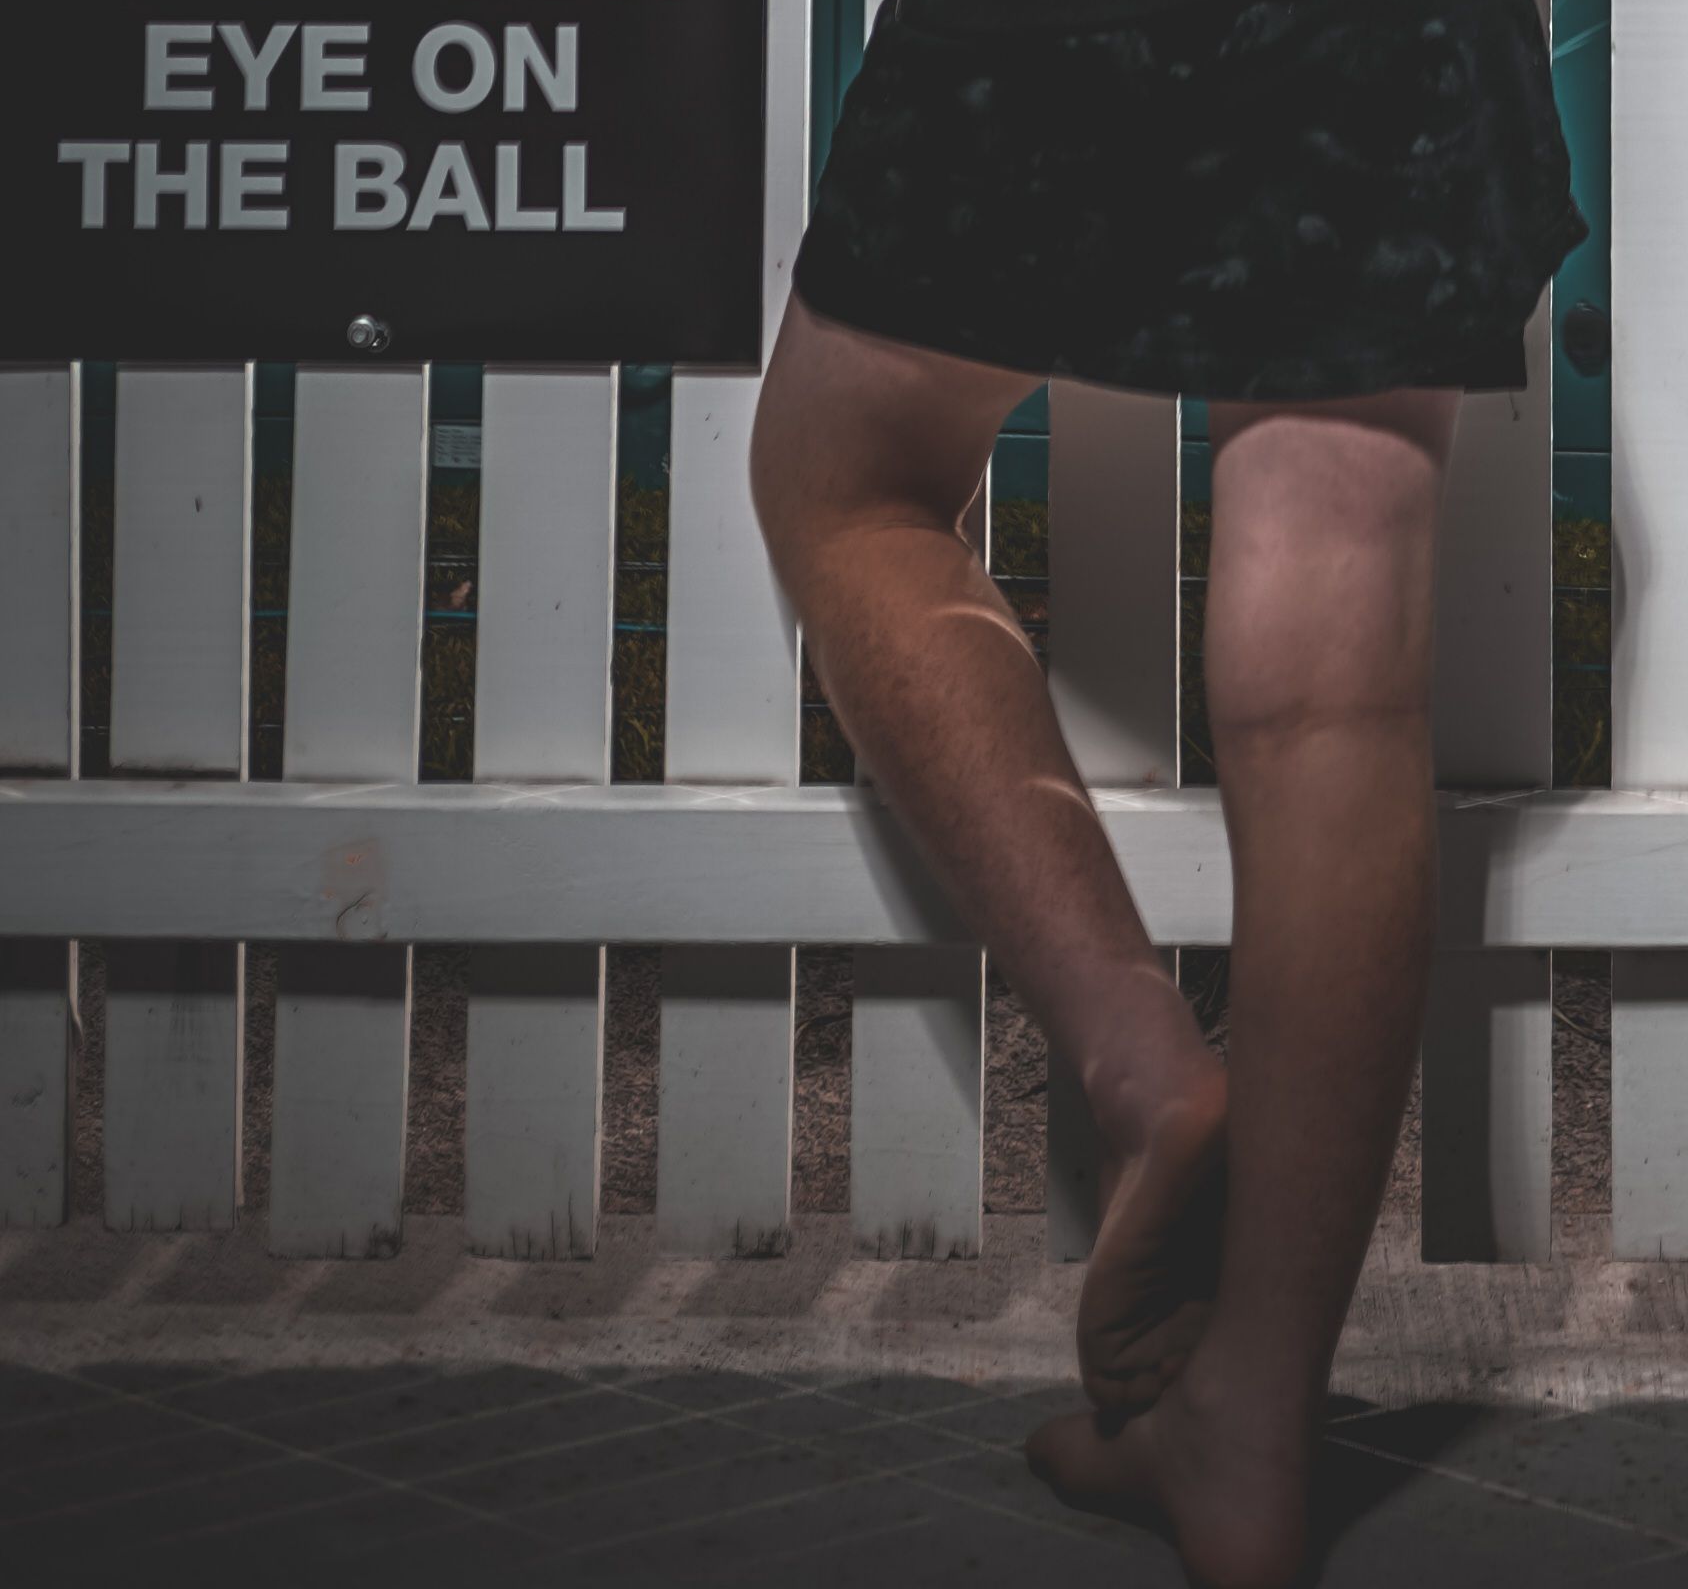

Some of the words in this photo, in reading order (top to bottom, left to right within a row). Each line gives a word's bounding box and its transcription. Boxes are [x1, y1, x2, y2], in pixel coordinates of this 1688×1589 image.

[144, 23, 371, 112] EYE
[412, 23, 579, 113] ON
[57, 141, 290, 230] THE
[333, 142, 626, 232] BALL
